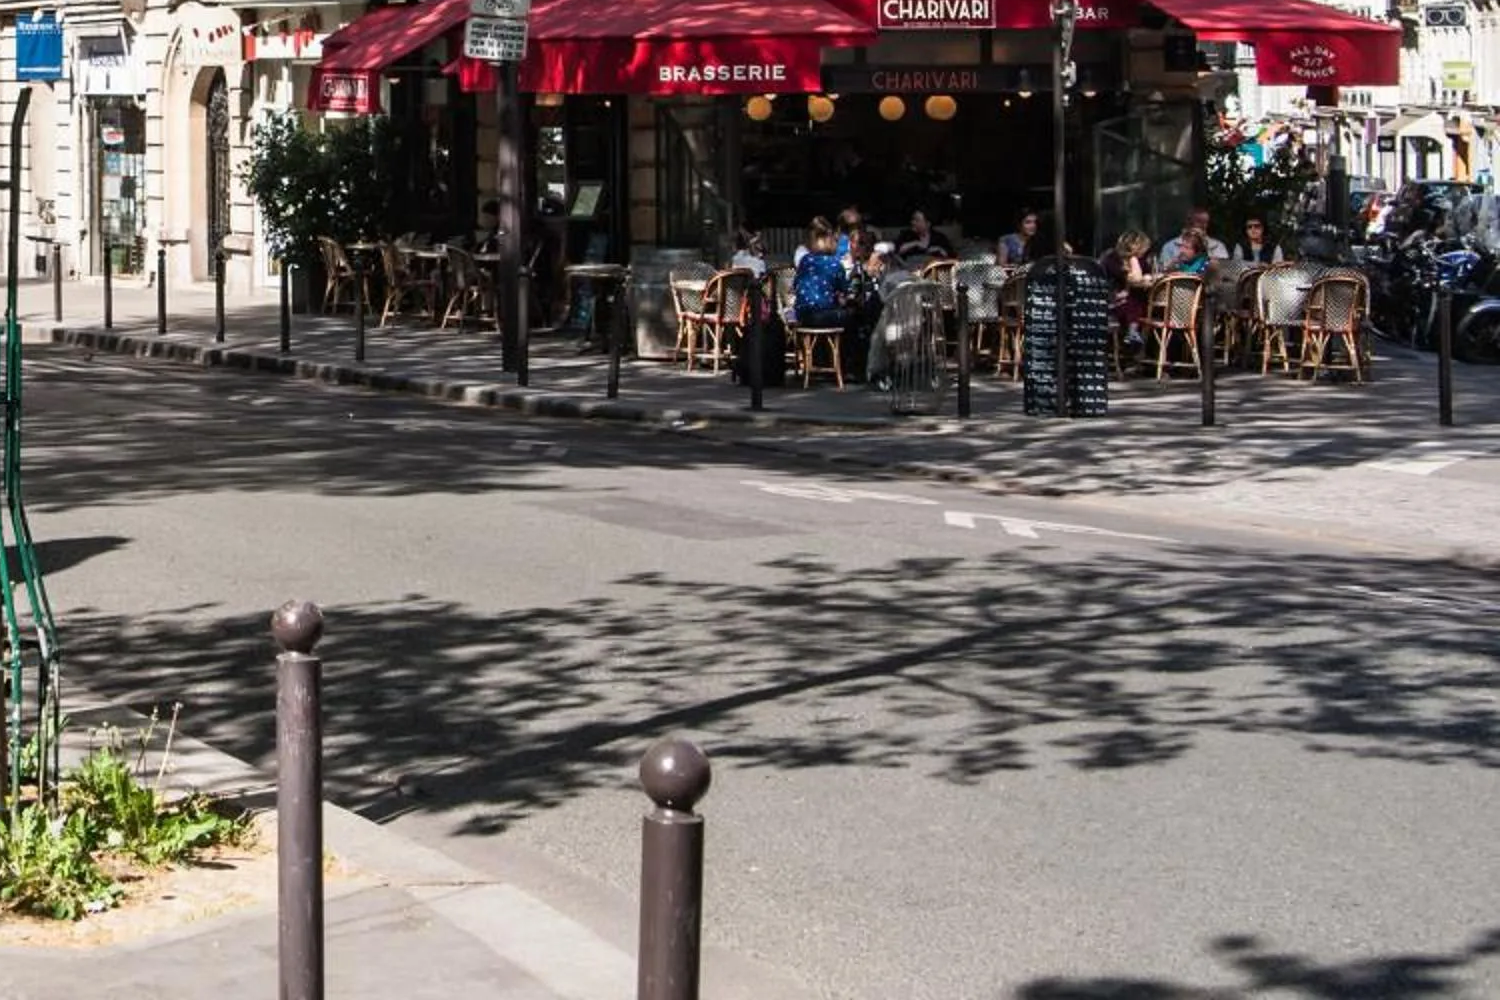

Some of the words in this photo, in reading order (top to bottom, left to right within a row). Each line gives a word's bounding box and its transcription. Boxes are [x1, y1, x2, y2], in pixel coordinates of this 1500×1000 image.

[883, 0, 989, 19] CHARIVARI
[1075, 7, 1109, 21] BAR
[659, 64, 787, 81] BRASSERIE
[871, 71, 978, 90] CHARIVARI
